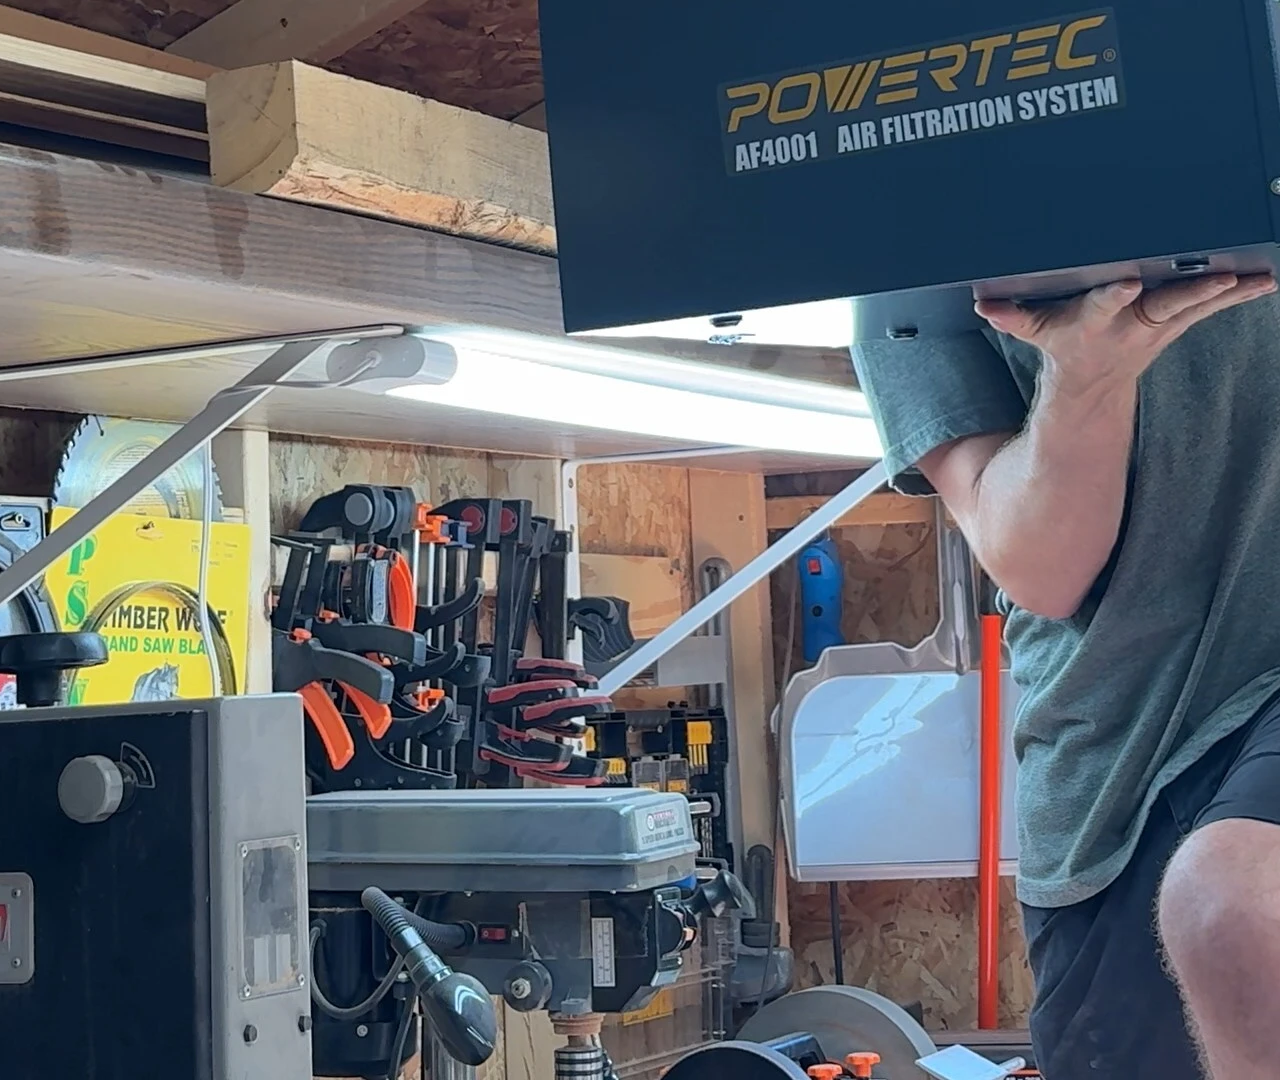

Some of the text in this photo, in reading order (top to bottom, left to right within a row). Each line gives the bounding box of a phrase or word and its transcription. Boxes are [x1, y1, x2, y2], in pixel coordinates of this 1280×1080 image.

[725, 14, 1109, 133] POWERTEC
[735, 76, 1118, 172] AF4001 AIR FILTRATION SYSTEM
[104, 604, 227, 633] IMBER WF
[143, 637, 175, 654] SAW
